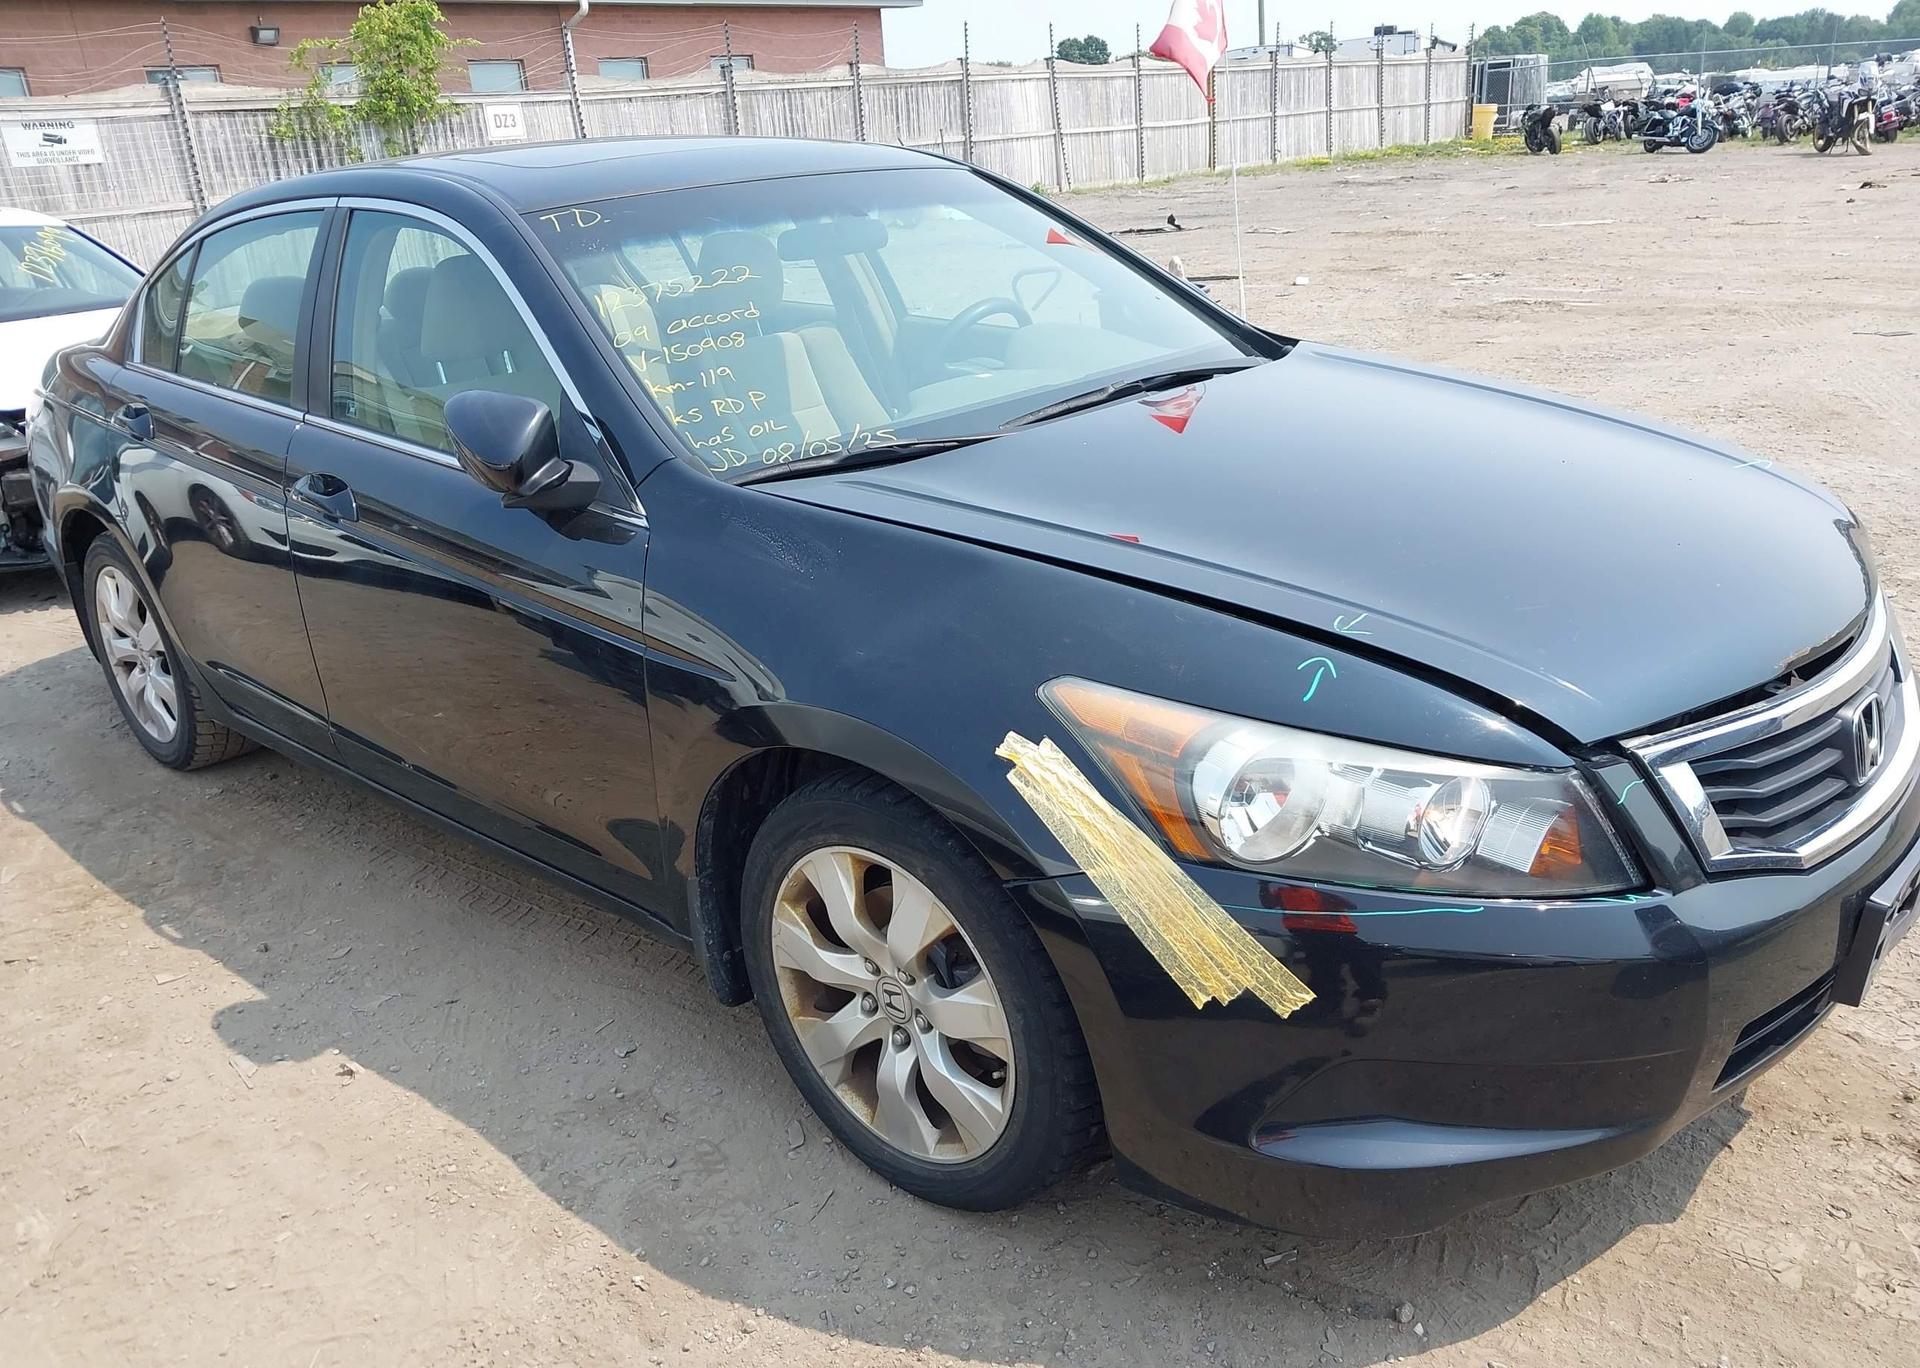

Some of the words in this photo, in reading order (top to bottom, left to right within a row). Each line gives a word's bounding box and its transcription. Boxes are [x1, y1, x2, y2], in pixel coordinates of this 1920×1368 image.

[21, 120, 75, 131] WARNING
[493, 113, 517, 129] DZ3
[32, 150, 48, 158] AREA
[56, 149, 77, 157] UNDER
[36, 156, 80, 164] SURVEILLANCE
[594, 265, 762, 319] 12375222
[613, 325, 650, 348] 09
[667, 301, 761, 334] accord
[685, 427, 735, 449] has
[710, 449, 748, 472] JD
[762, 423, 898, 464] 08/05/25
